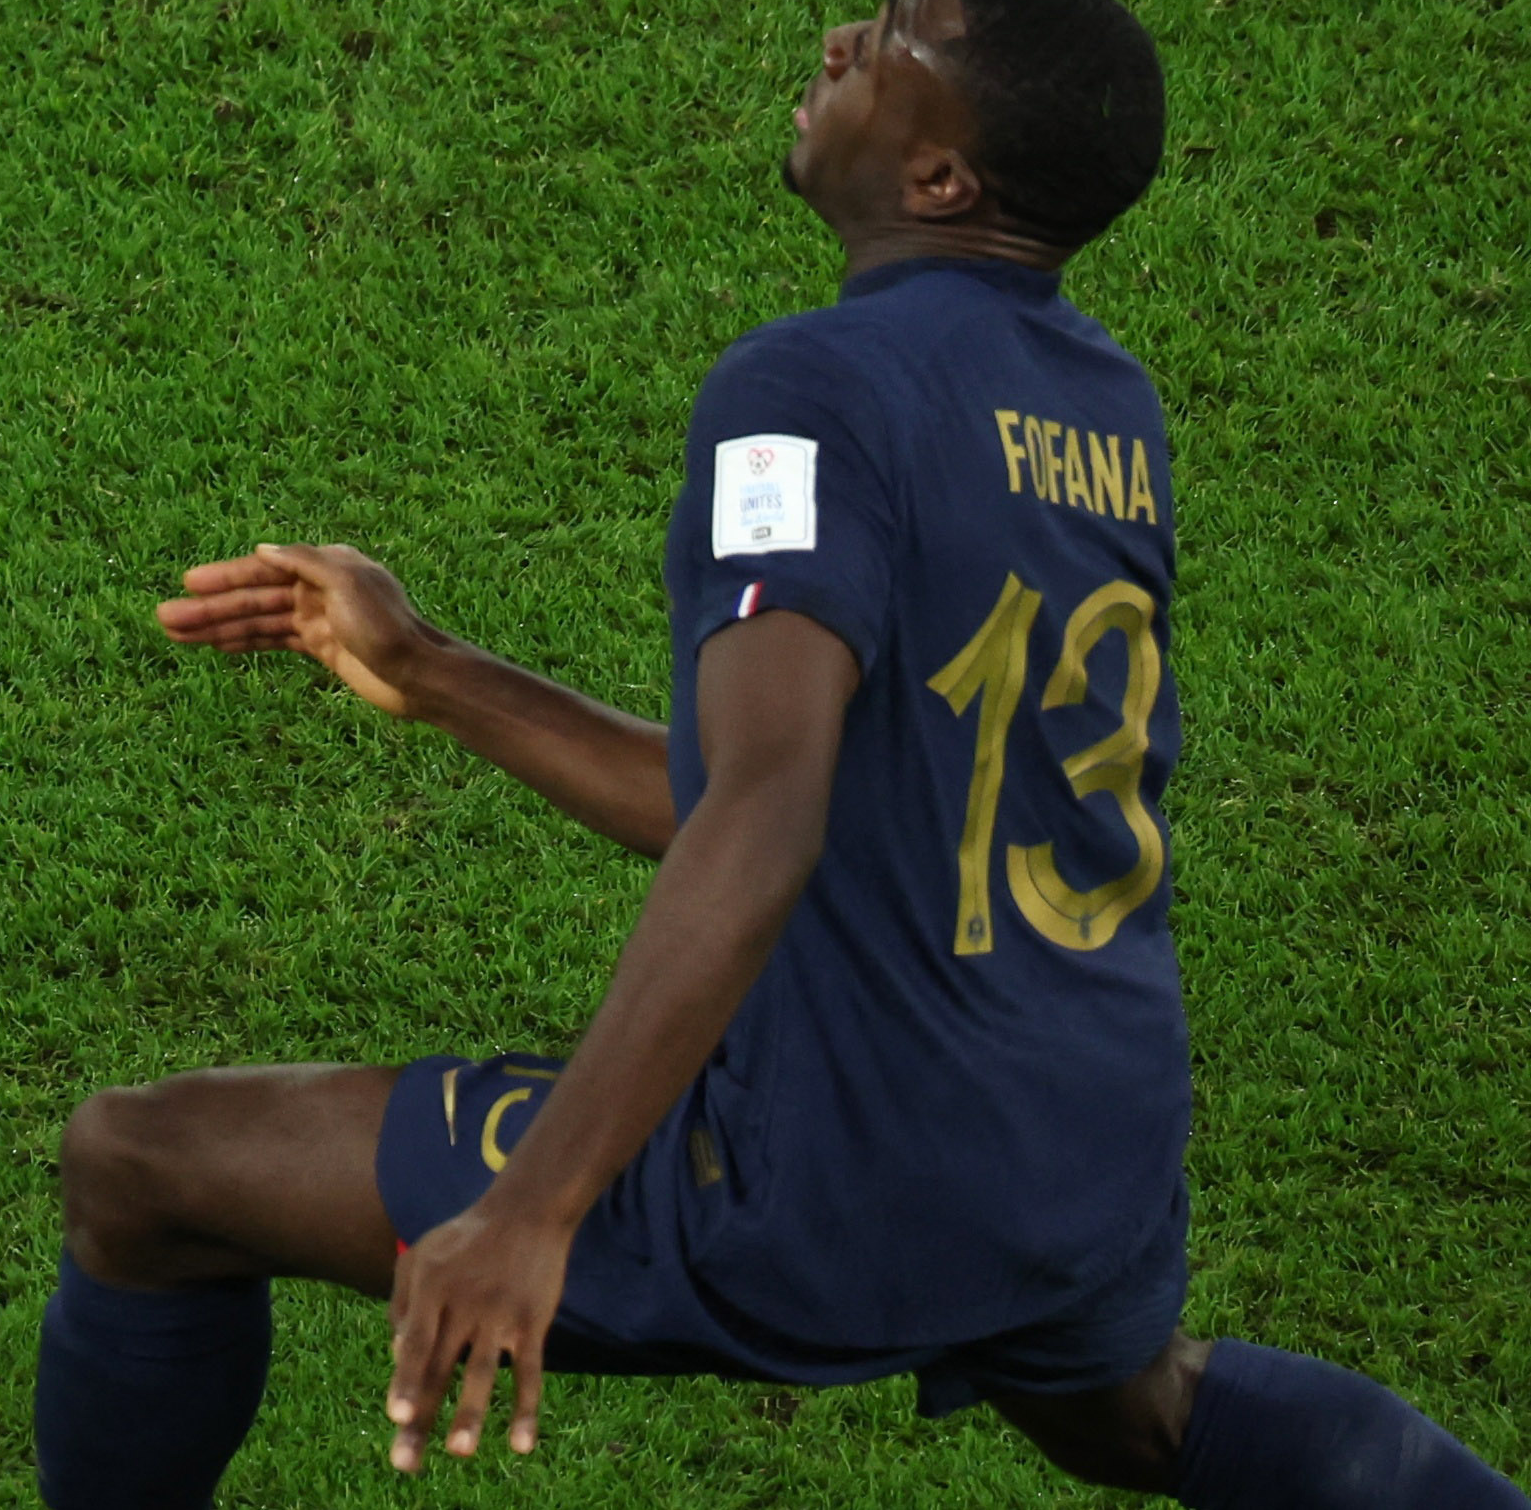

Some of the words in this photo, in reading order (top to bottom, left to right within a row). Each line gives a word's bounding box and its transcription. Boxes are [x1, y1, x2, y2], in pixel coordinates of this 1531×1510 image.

[740, 494, 783, 513] UNITES
[993, 409, 1157, 526] FOFANA
[926, 570, 1165, 956] 13
